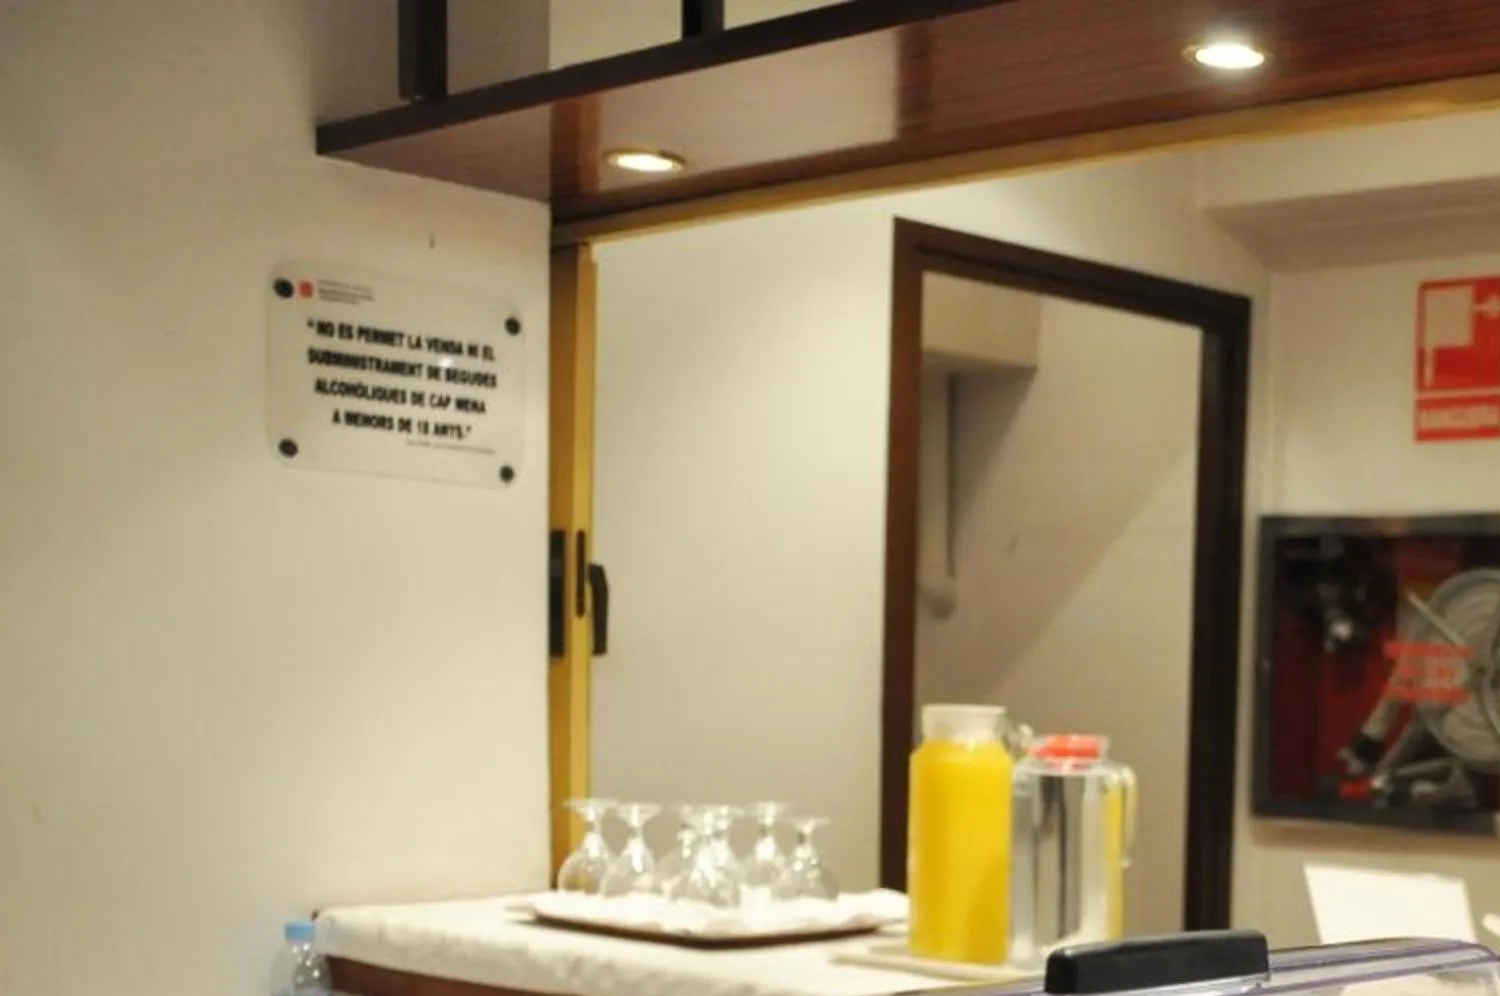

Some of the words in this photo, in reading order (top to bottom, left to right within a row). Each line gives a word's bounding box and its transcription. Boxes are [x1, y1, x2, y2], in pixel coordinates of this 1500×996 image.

[338, 322, 354, 341] ES
[407, 335, 423, 350] LA
[481, 345, 495, 361] EL
[426, 365, 441, 382] DE
[410, 391, 425, 408] DE
[429, 393, 452, 411] CAP
[332, 409, 341, 425] A
[397, 417, 412, 434] DE
